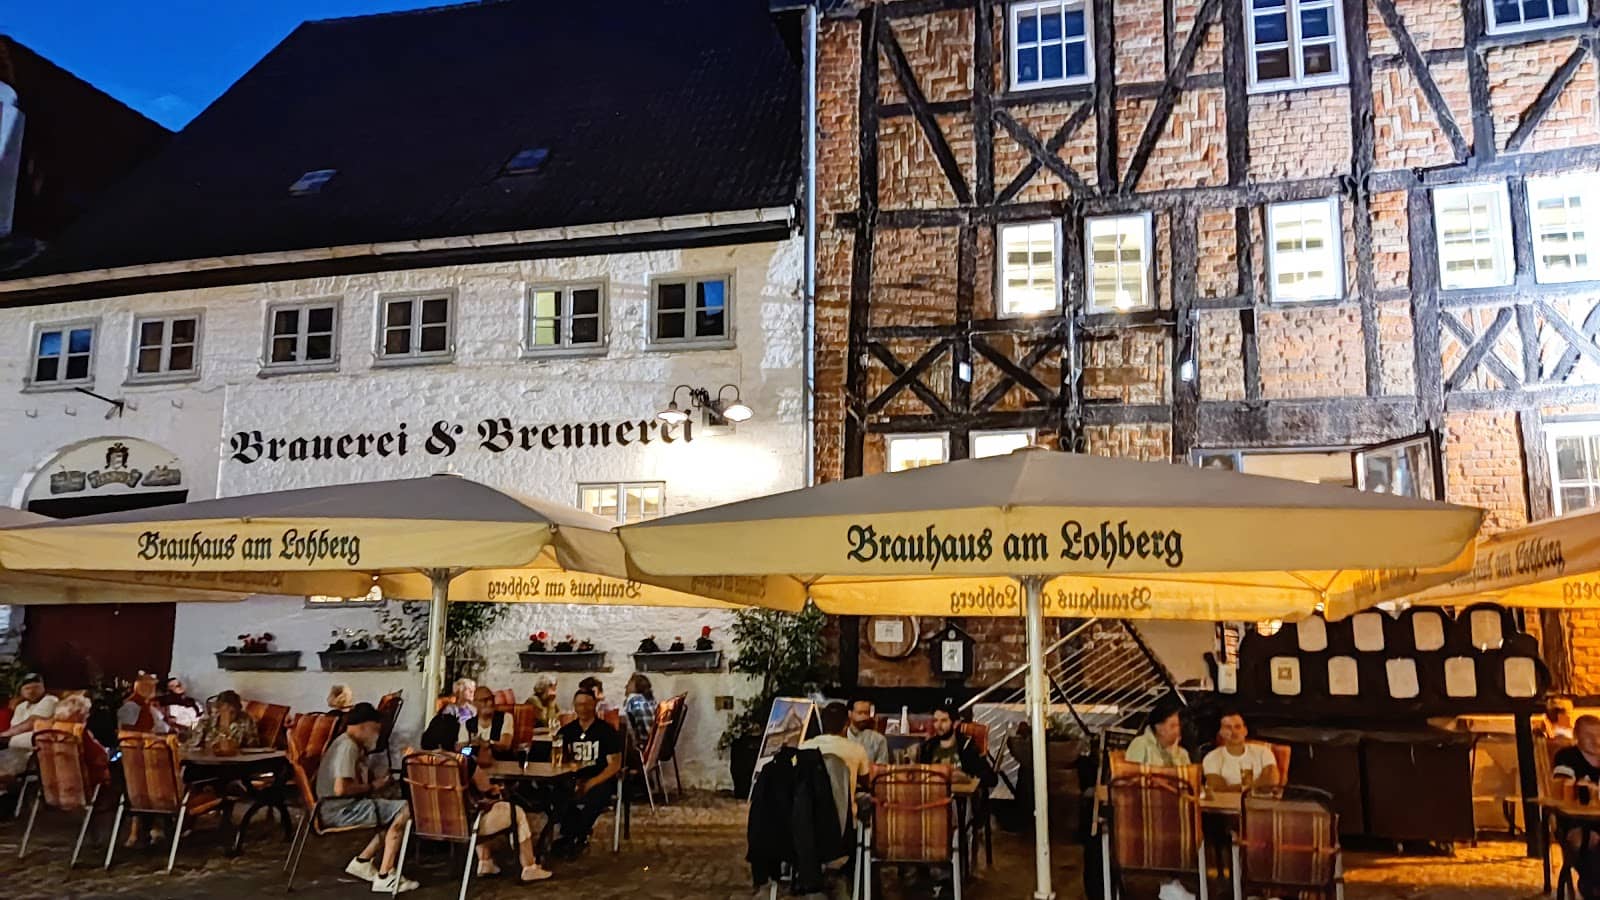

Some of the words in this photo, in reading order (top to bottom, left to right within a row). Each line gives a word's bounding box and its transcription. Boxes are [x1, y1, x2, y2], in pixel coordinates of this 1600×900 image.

[230, 422, 408, 464] Brauerei
[425, 419, 464, 458] &
[477, 408, 693, 453] Brennerei
[137, 531, 235, 566] Brauhaus
[241, 539, 272, 561] am
[278, 528, 361, 566] Lohberg
[847, 523, 993, 570] Brauhaus
[1003, 535, 1049, 562] am
[1060, 520, 1184, 569] Lohberg
